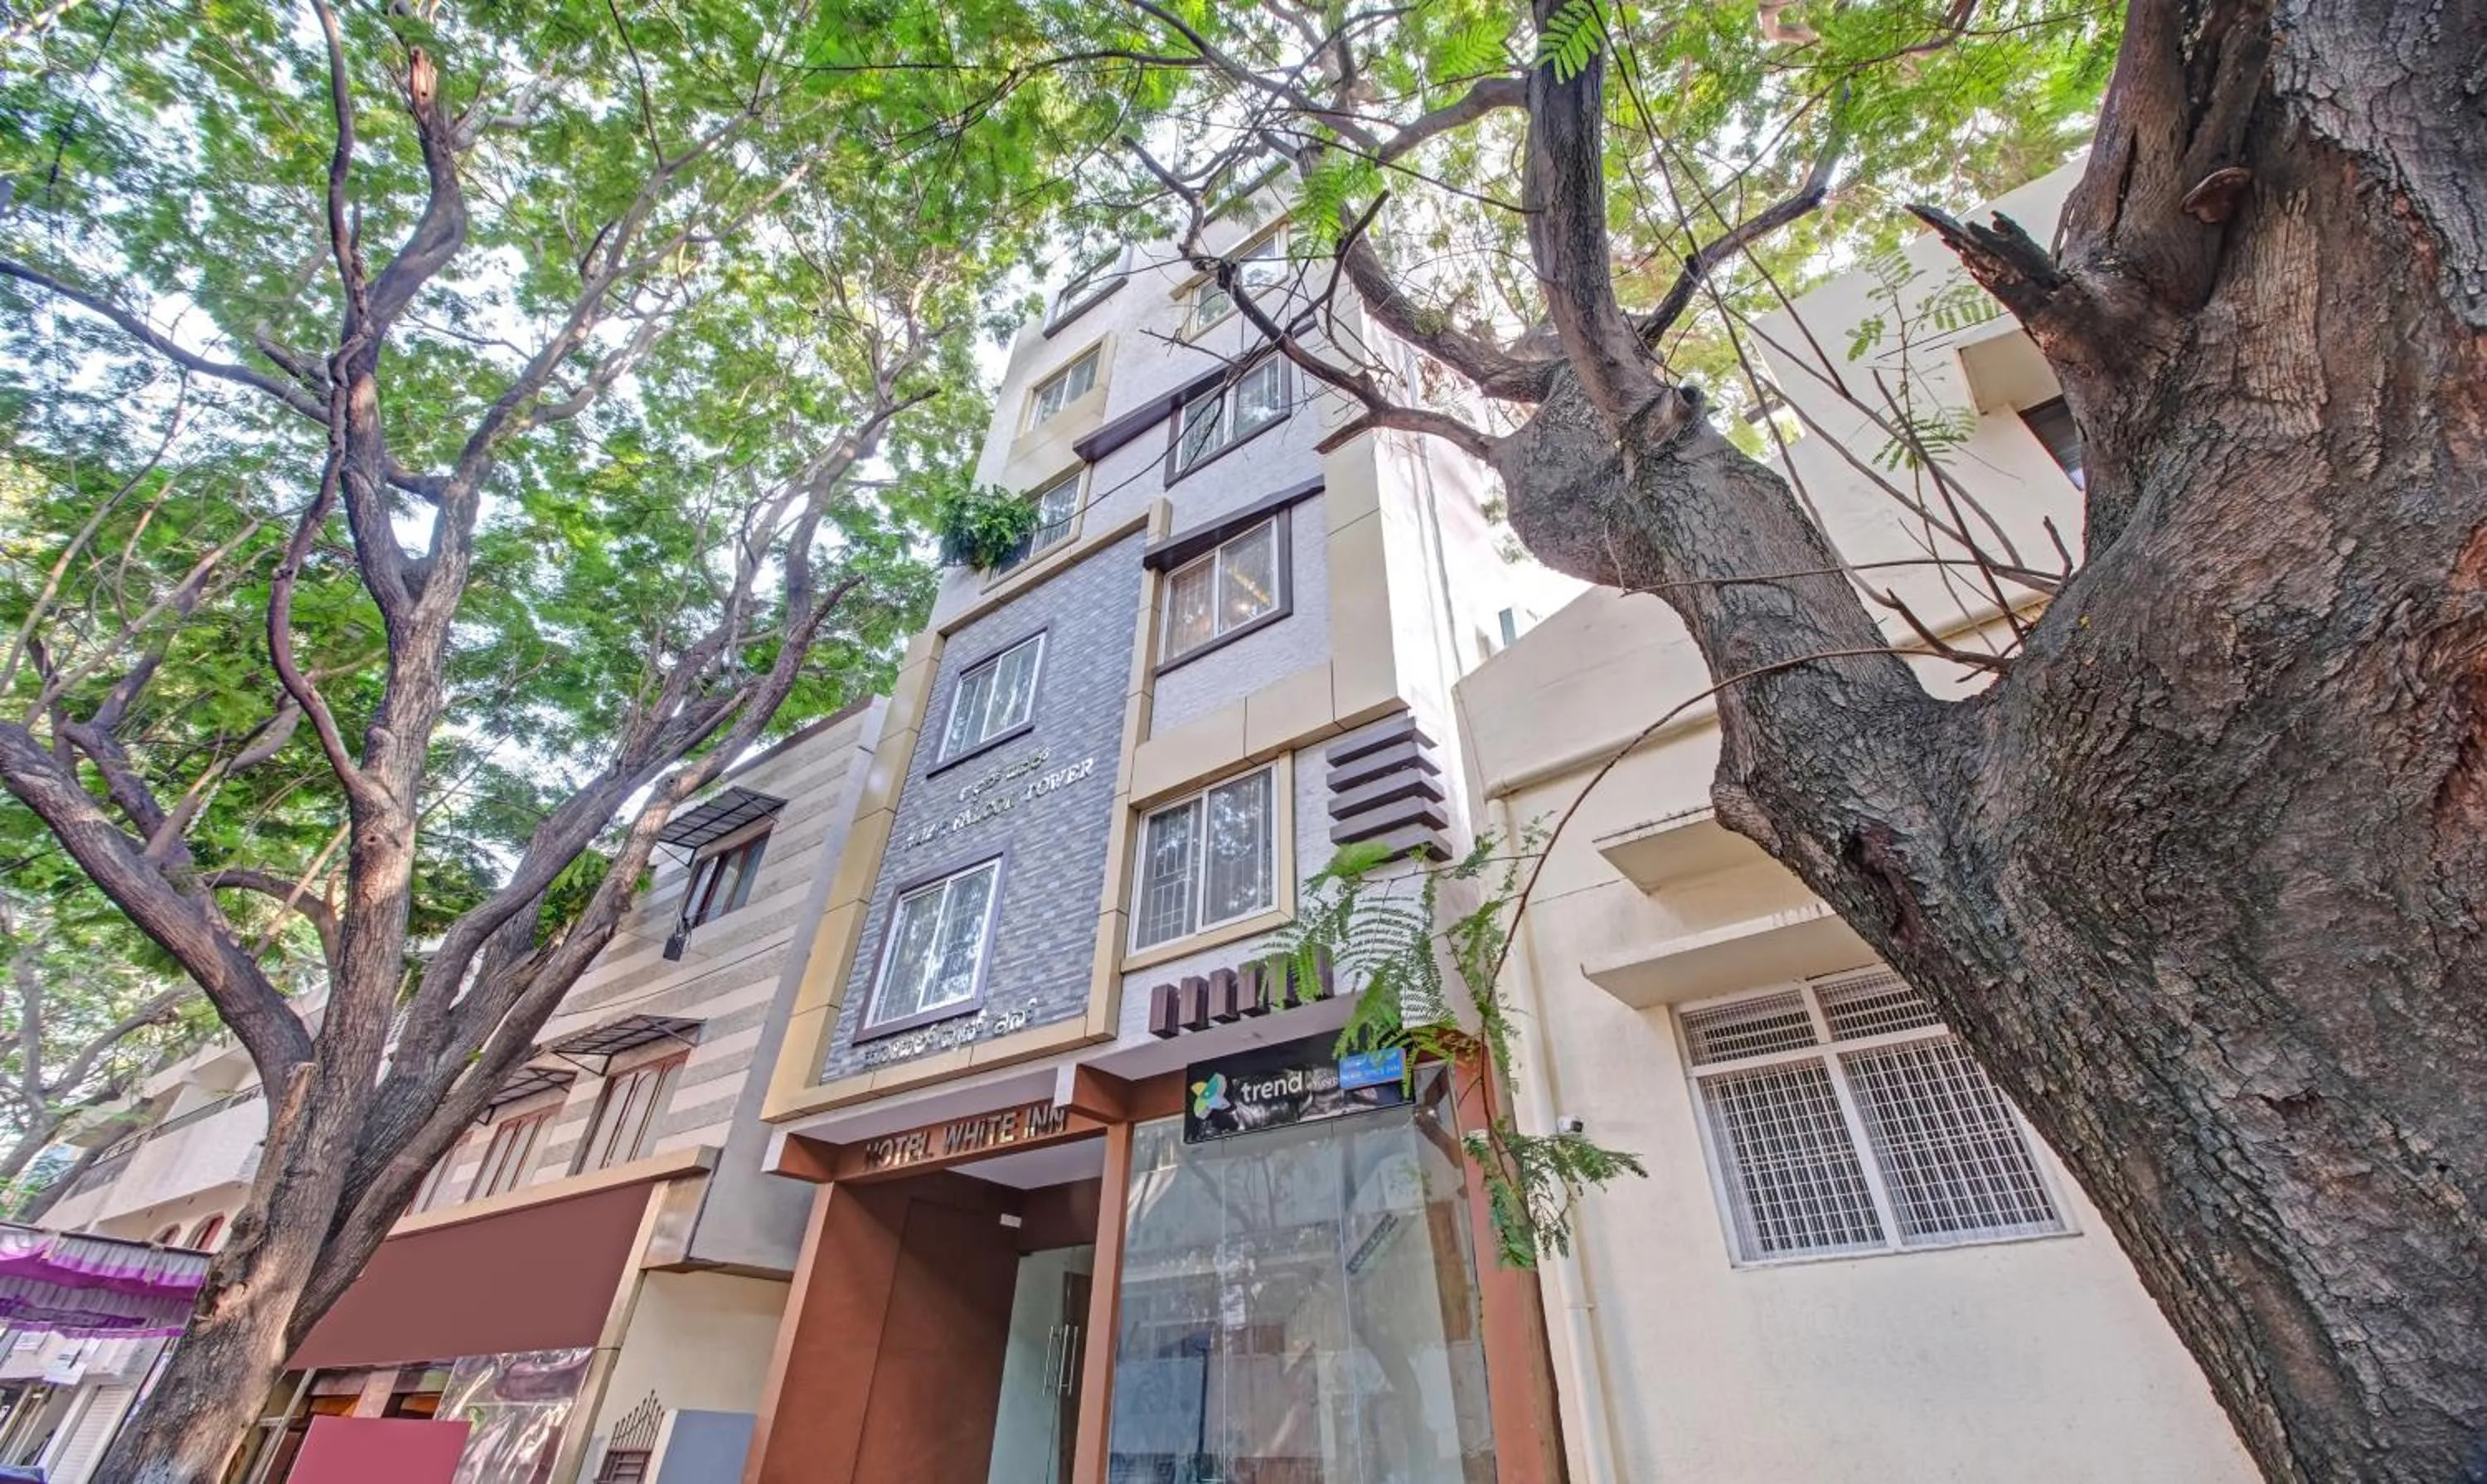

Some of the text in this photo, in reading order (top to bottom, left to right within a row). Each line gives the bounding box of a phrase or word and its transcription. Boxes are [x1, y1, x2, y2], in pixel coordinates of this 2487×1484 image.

[1025, 758, 1094, 800] TOWER
[1241, 1071, 1304, 1103] trend
[864, 1104, 1067, 1170] HOTEL WHITE INN
